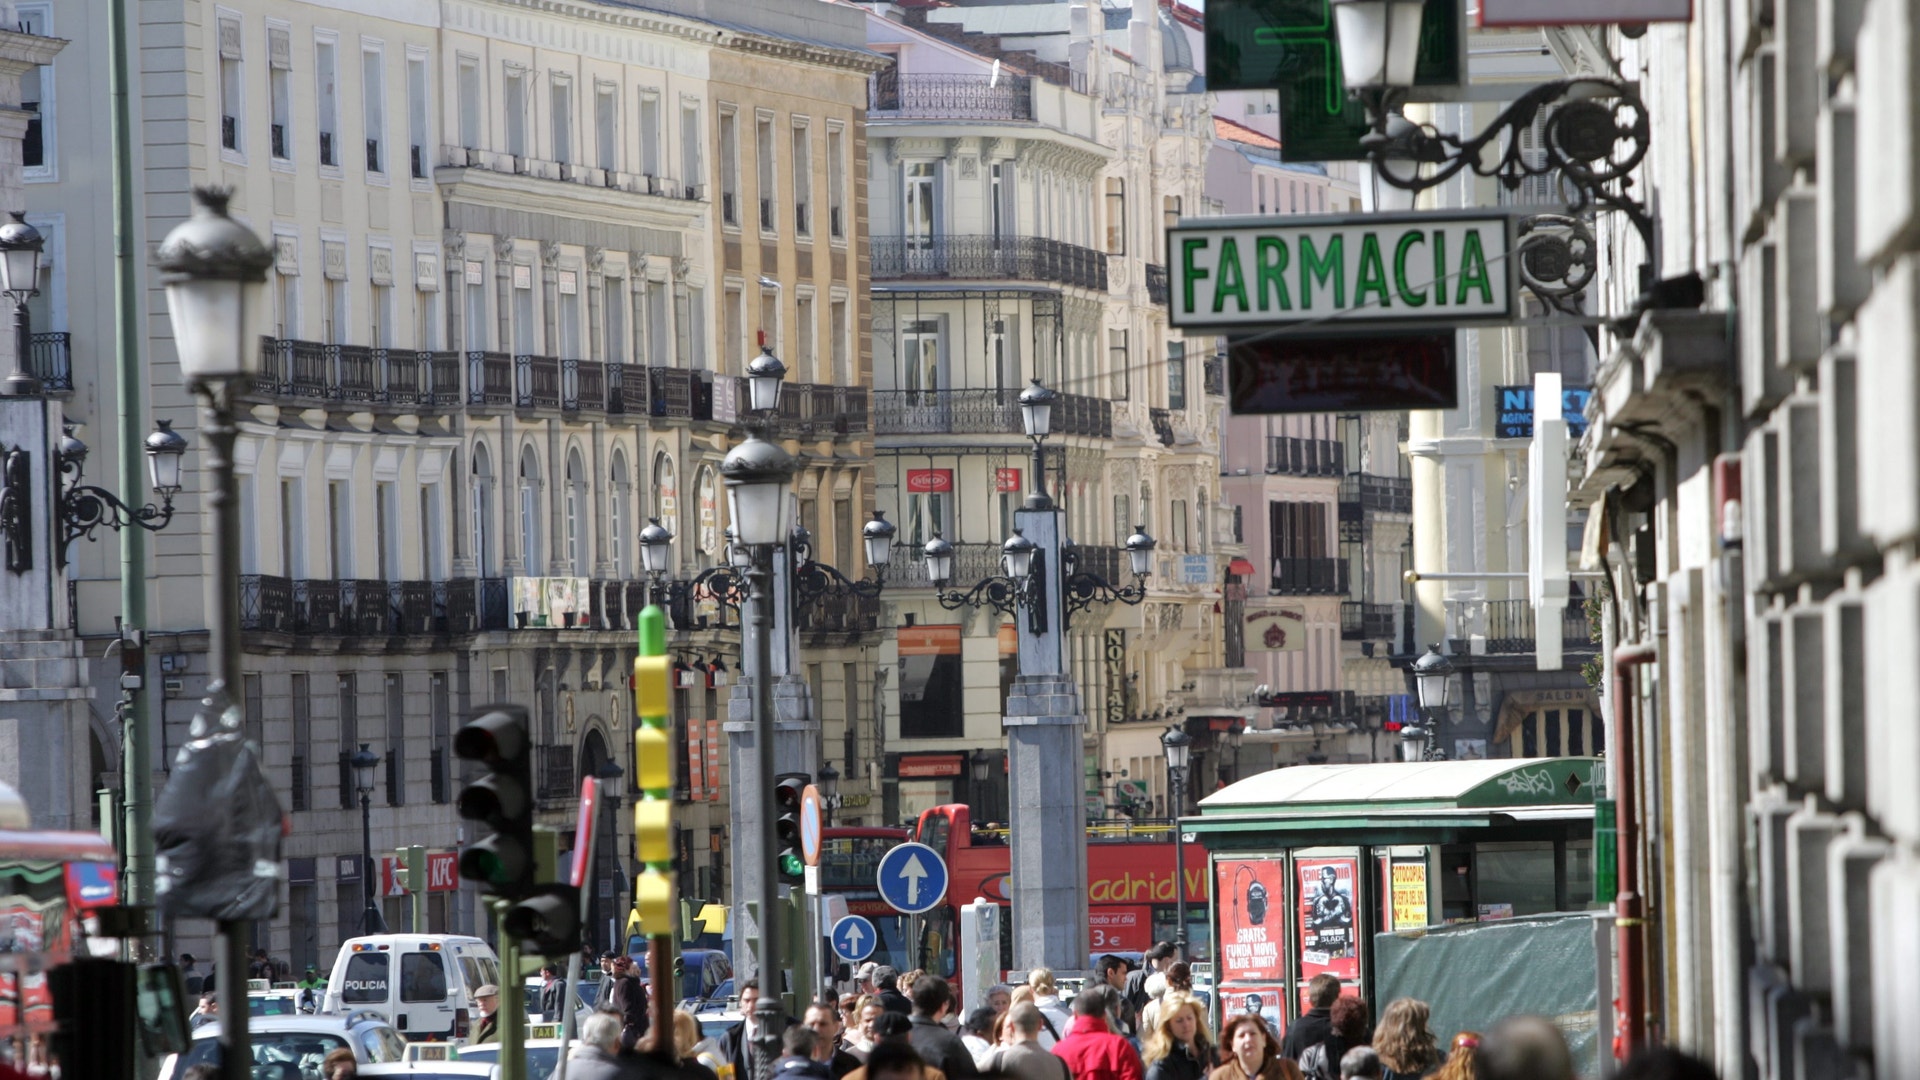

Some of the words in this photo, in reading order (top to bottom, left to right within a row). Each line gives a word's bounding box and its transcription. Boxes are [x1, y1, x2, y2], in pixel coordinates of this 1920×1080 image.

[1182, 228, 1495, 314] FARMACIA
[1503, 390, 1593, 410] NXT
[1107, 630, 1125, 722] NOVIAS
[431, 857, 455, 887] KFC
[1303, 867, 1350, 882] CINENIA
[1089, 871, 1178, 901] adrid
[1089, 914, 1110, 924] todo
[1111, 914, 1120, 924] el
[1121, 914, 1136, 924] día
[1404, 908, 1409, 919] 4
[1092, 929, 1105, 947] 3
[1237, 928, 1267, 943] GRATIS
[1226, 943, 1253, 960] FUNDA
[1229, 957, 1250, 970] BLADE
[1251, 955, 1276, 968] TRINITY
[532, 1025, 555, 1038] TAXI
[420, 1046, 446, 1060] TAXI
